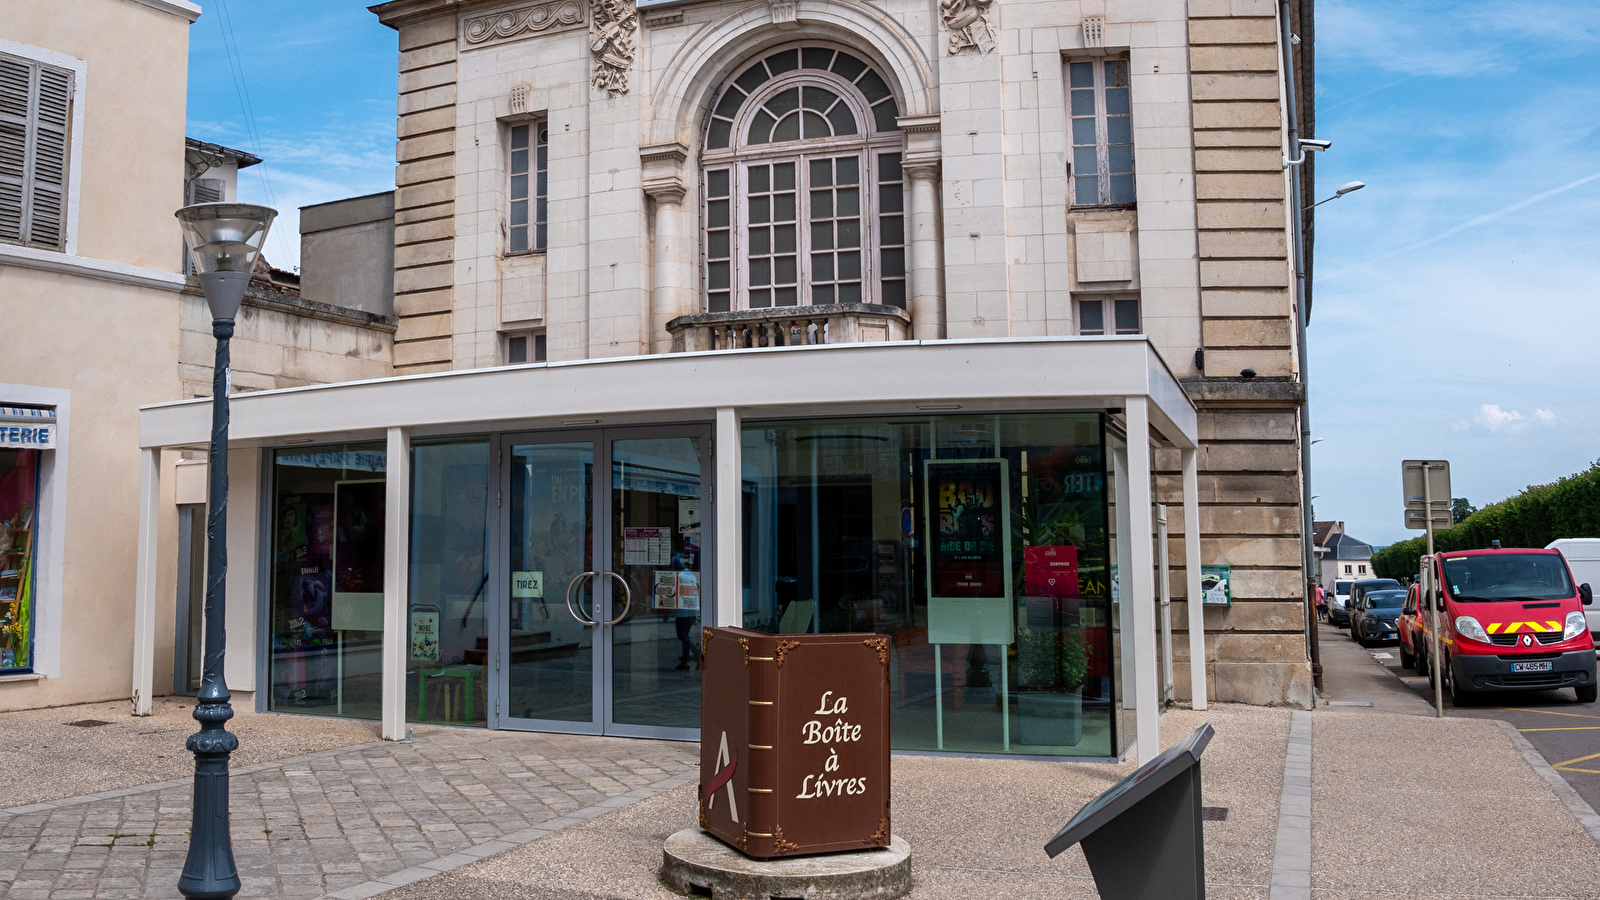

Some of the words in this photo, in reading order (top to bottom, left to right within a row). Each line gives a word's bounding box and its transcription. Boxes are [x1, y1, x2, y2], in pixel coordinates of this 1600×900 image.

[0, 427, 49, 444] TERIE
[551, 485, 567, 502] EN
[939, 479, 994, 509] BAD
[301, 566, 319, 575] ENNUI
[516, 580, 538, 589] TIREZ
[814, 690, 849, 716] La
[802, 718, 862, 745] Boîte
[824, 747, 840, 773] à
[796, 773, 867, 800] Livres
